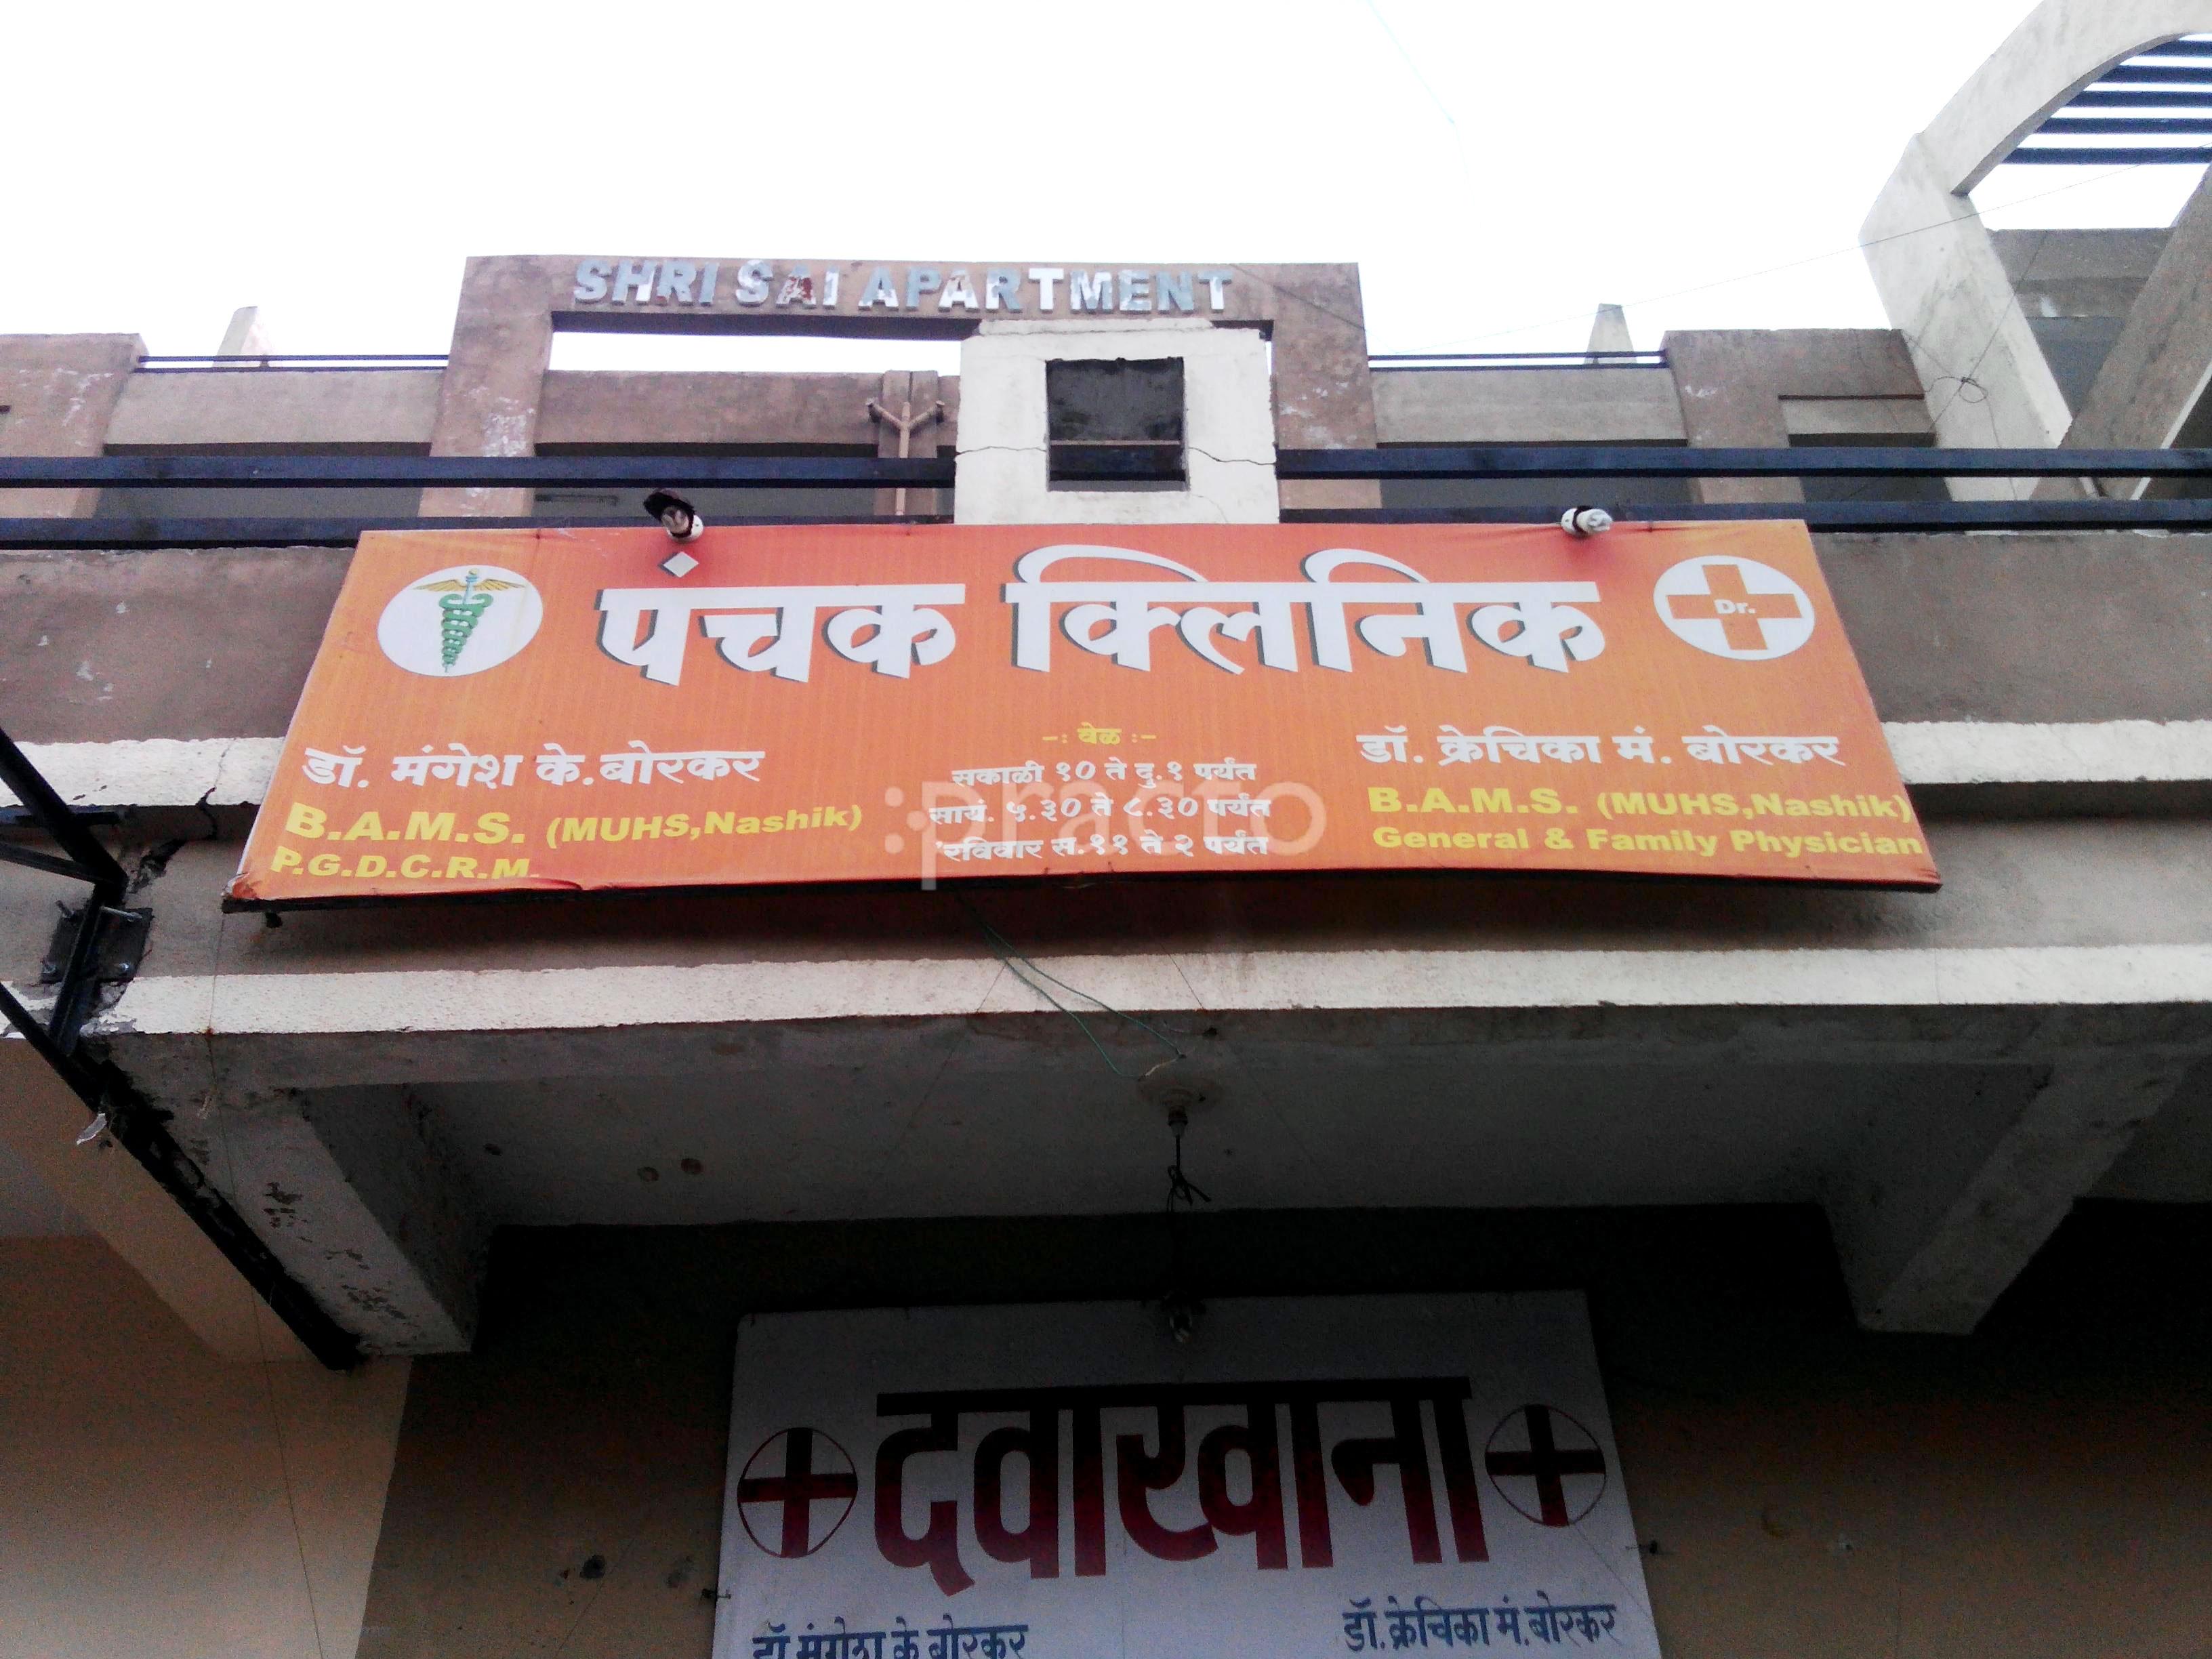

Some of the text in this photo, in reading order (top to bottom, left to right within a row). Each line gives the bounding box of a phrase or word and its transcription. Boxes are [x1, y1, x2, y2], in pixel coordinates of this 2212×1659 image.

[573, 259, 1232, 314] SHRI SAI APARTMENT
[594, 544, 1606, 685] पंचक क्लिनिक
[1713, 599, 1756, 614] Dr.
[1356, 724, 1845, 766] डॉ. क्रेचिका मं. बोरकर
[302, 745, 369, 787] डॉ.
[391, 743, 524, 789] मंगेश
[951, 760, 1045, 787] सकाळी
[1056, 760, 1096, 781] १०
[1105, 756, 1127, 780] ते
[1193, 756, 1257, 780] पर्यंत
[928, 799, 995, 825] सायं.
[1090, 792, 1113, 817] ते
[1123, 797, 1198, 819] ८.३०
[1206, 792, 1271, 817] पर्यंत
[1368, 787, 1914, 823] B.A.M.S. (MUHS,Nashik)
[286, 802, 862, 848] B.A.M.S. (MUHS,Nashik)
[1139, 829, 1163, 854] ते
[1174, 834, 1194, 857] २
[1203, 830, 1269, 855] पर्यंत
[1373, 827, 1923, 858] General & Family Physician
[874, 1377, 1490, 1596] दवाखाना
